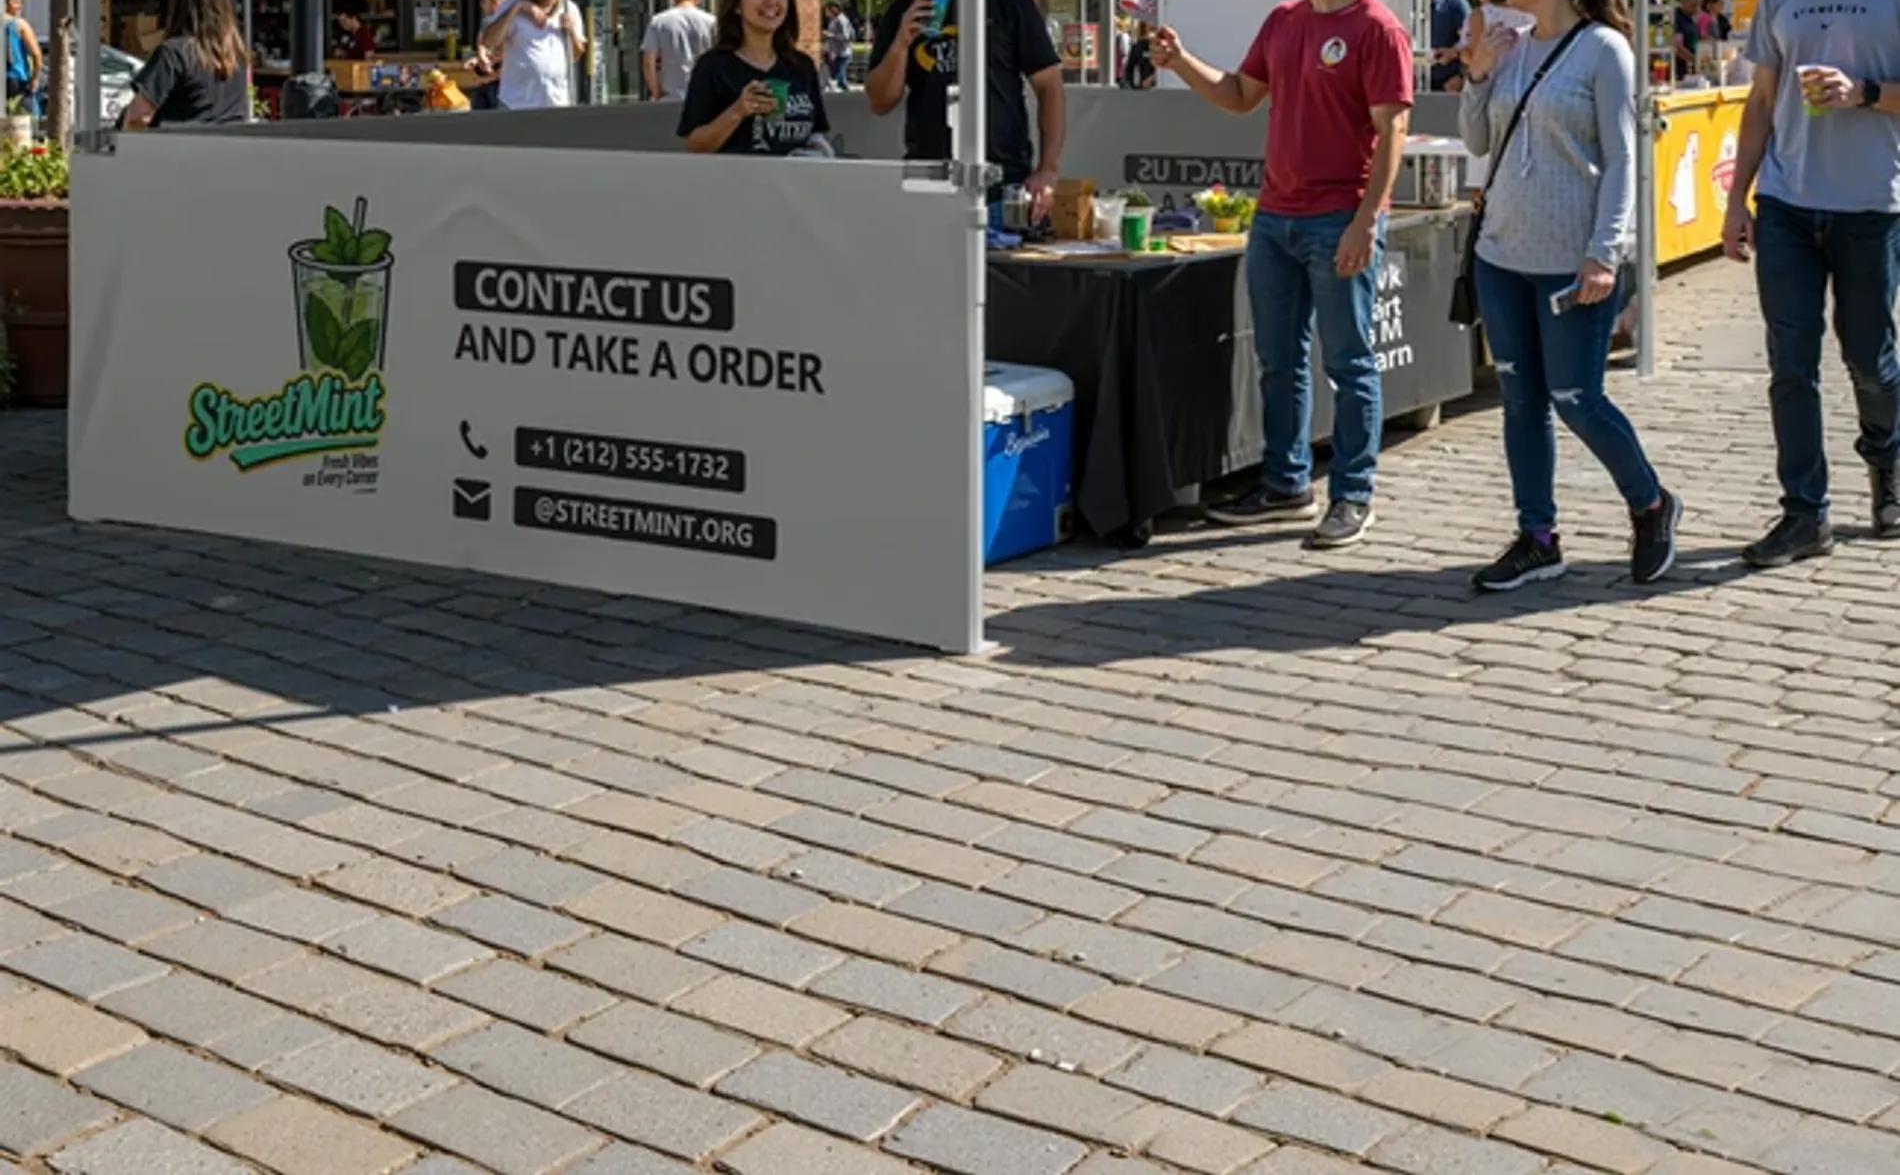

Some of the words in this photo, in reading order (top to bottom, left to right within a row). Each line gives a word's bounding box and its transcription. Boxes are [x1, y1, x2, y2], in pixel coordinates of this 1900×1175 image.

[474, 268, 650, 320] CONTACT
[661, 282, 711, 324] US
[454, 323, 537, 366] AND
[545, 330, 640, 376] TAKE
[649, 340, 678, 380] A
[687, 343, 825, 395] ORDER
[186, 373, 385, 457] StreetMint
[529, 436, 556, 460] +1
[563, 438, 619, 472] (212)
[625, 446, 730, 481] 555-1732
[534, 495, 754, 548] @STREETMINT.ORG
